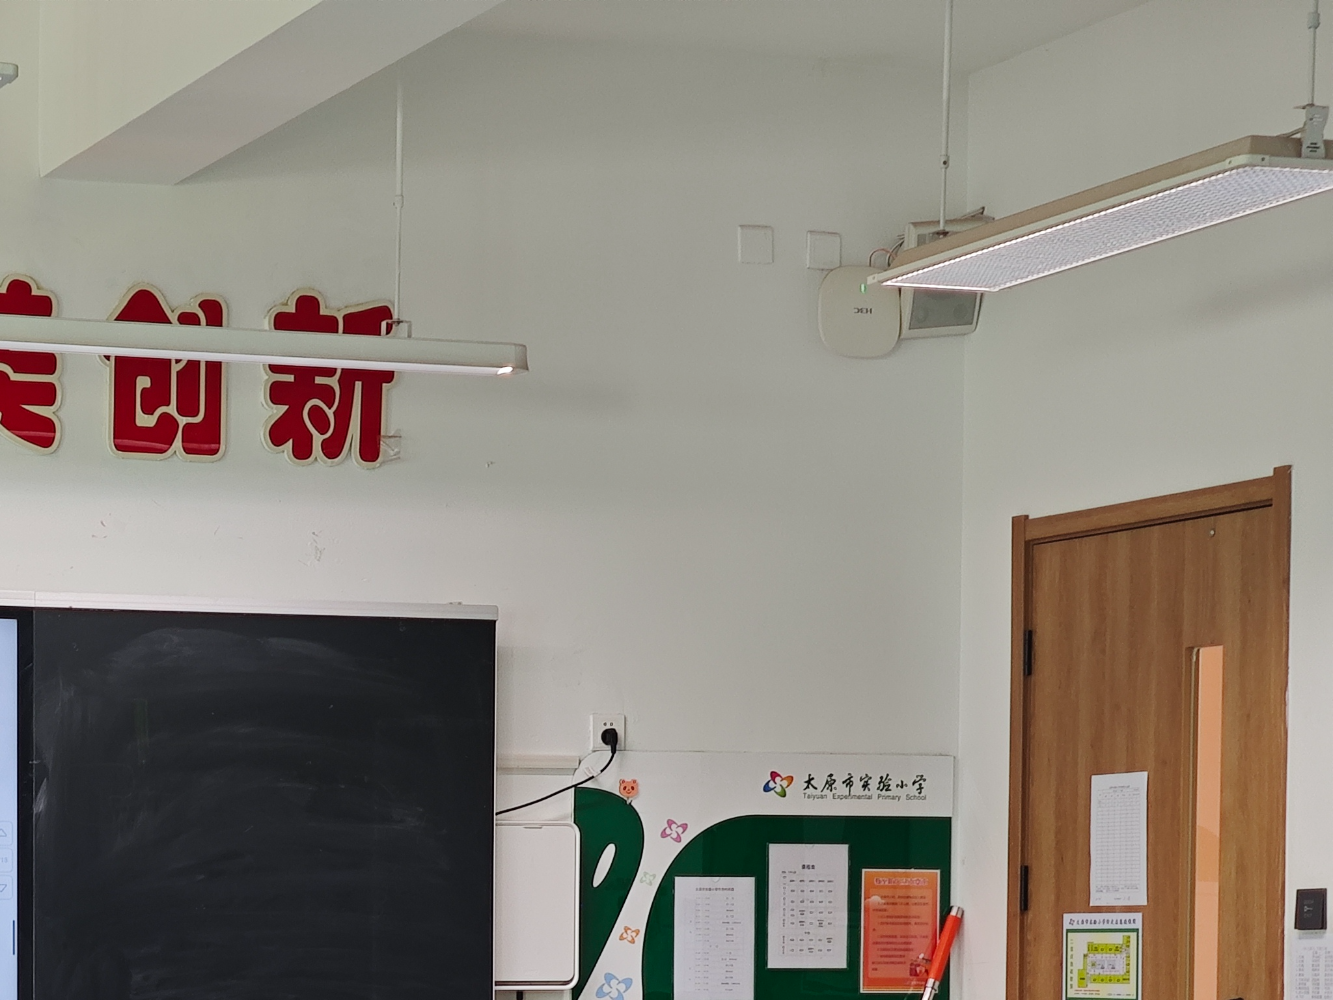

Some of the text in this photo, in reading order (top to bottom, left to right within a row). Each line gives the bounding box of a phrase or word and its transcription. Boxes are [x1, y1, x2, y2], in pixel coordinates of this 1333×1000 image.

[803, 773, 927, 796] 太原市实验小学
[803, 793, 927, 802] Taiyuan Experimental Primary School
